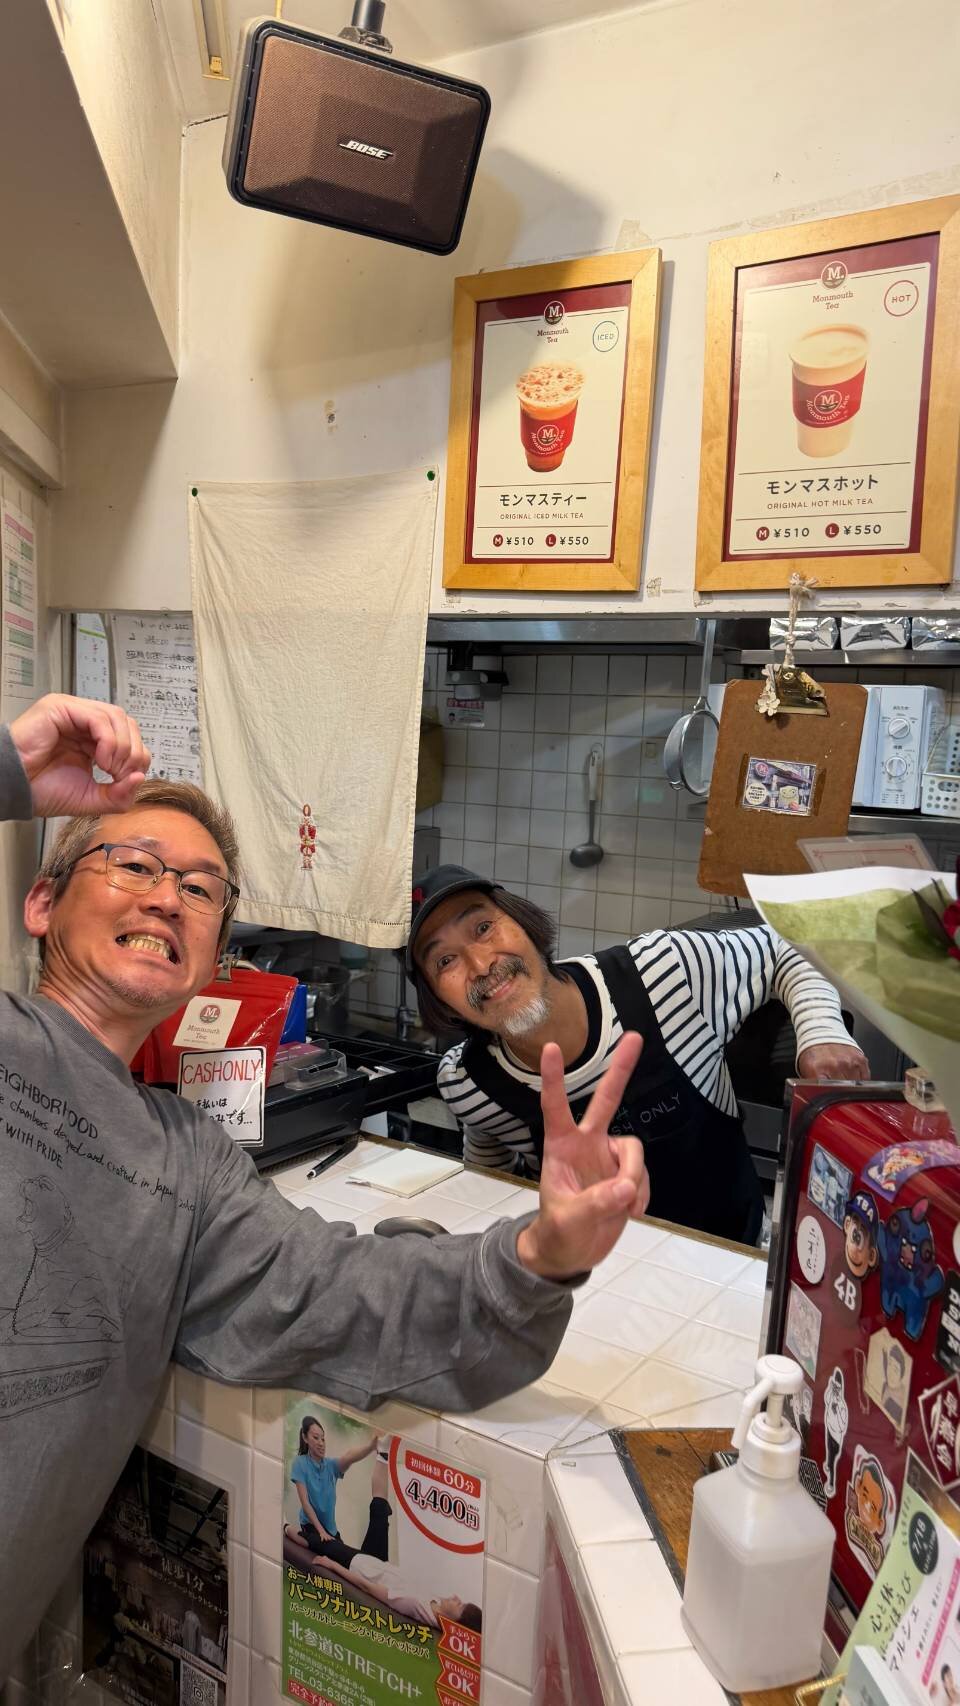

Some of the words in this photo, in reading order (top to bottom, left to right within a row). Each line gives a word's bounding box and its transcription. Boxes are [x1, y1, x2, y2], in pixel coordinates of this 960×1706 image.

[339, 140, 394, 160] BOSE
[812, 292, 854, 303] Monmouth
[826, 302, 840, 310] Tea
[891, 295, 911, 303] HOT
[536, 328, 569, 337] Monmouth
[597, 333, 615, 341] ICED
[807, 399, 841, 421] Monmouth
[531, 432, 559, 452] Monmouth
[766, 474, 879, 495] モンマスホット
[499, 492, 587, 507] モンマスティー
[767, 501, 808, 511] ORIGINAL
[811, 500, 829, 508] HOT
[832, 498, 853, 507] MILK
[857, 497, 874, 506] TEA
[506, 536, 534, 546] ¥510
[560, 535, 589, 546] ¥550
[774, 527, 810, 538] ¥510
[844, 524, 881, 536] ¥550
[640, 1092, 681, 1123] ONLY
[6, 1122, 34, 1148] WITH
[37, 1139, 64, 1170] PRIDE
[856, 1196, 874, 1222] TBA
[834, 1272, 857, 1310] 4B
[407, 1480, 478, 1528] 4,400円
[288, 1567, 343, 1597] お一人様専用
[289, 1583, 433, 1644] パーソナルストレッチ
[449, 1635, 476, 1661] OK
[890, 1605, 919, 1671] マルシェ
[448, 1672, 475, 1697] OK
